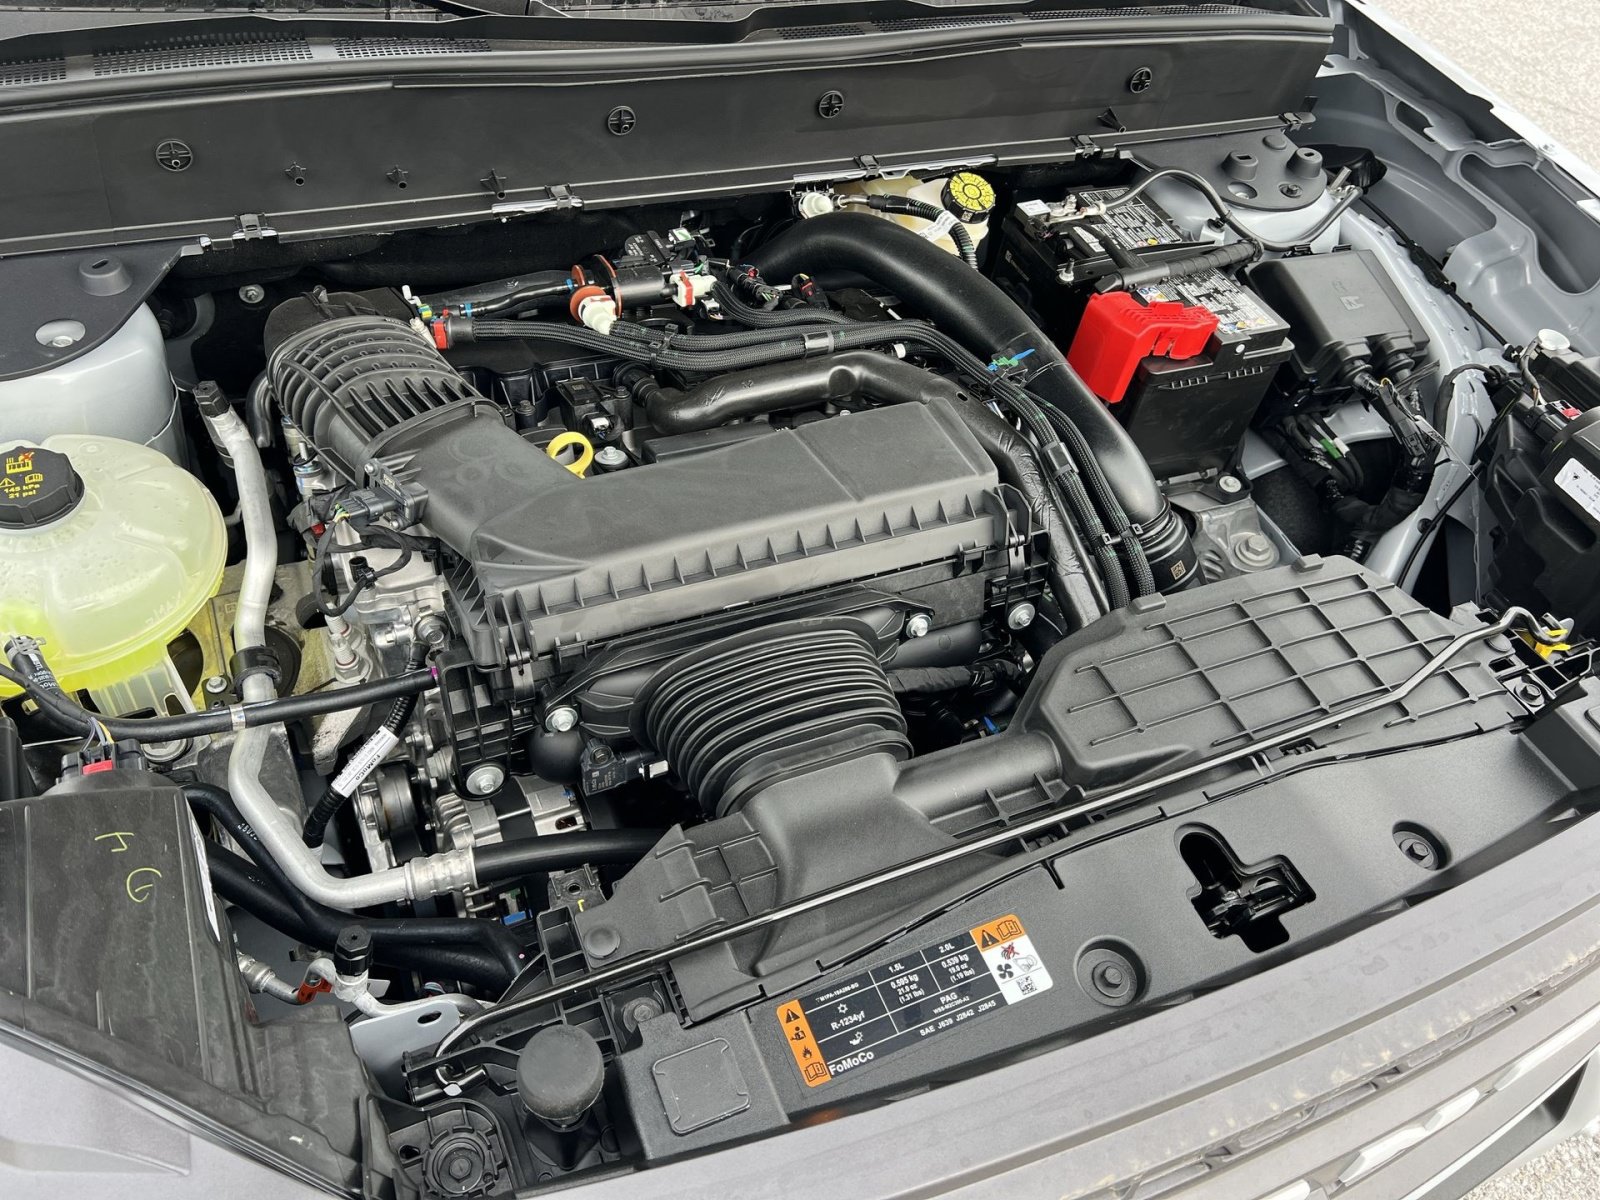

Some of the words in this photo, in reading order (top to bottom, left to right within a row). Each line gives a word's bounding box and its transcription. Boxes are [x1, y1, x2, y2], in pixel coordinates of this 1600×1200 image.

[356, 754, 381, 781] FoMoCo
[938, 942, 955, 953] 2.0L
[888, 962, 905, 973] 1.5L
[941, 956, 959, 969] 0.539
[958, 953, 970, 962] kg
[963, 967, 976, 977] lbs)
[890, 977, 909, 989] 0.595
[908, 974, 919, 982] kg
[912, 988, 925, 998] lbs)
[940, 992, 958, 1004] PAG
[830, 1010, 866, 1030] R-1234yf
[919, 1025, 935, 1036] SAE
[937, 1018, 954, 1029] J639
[828, 1051, 874, 1076] FoMoCo
